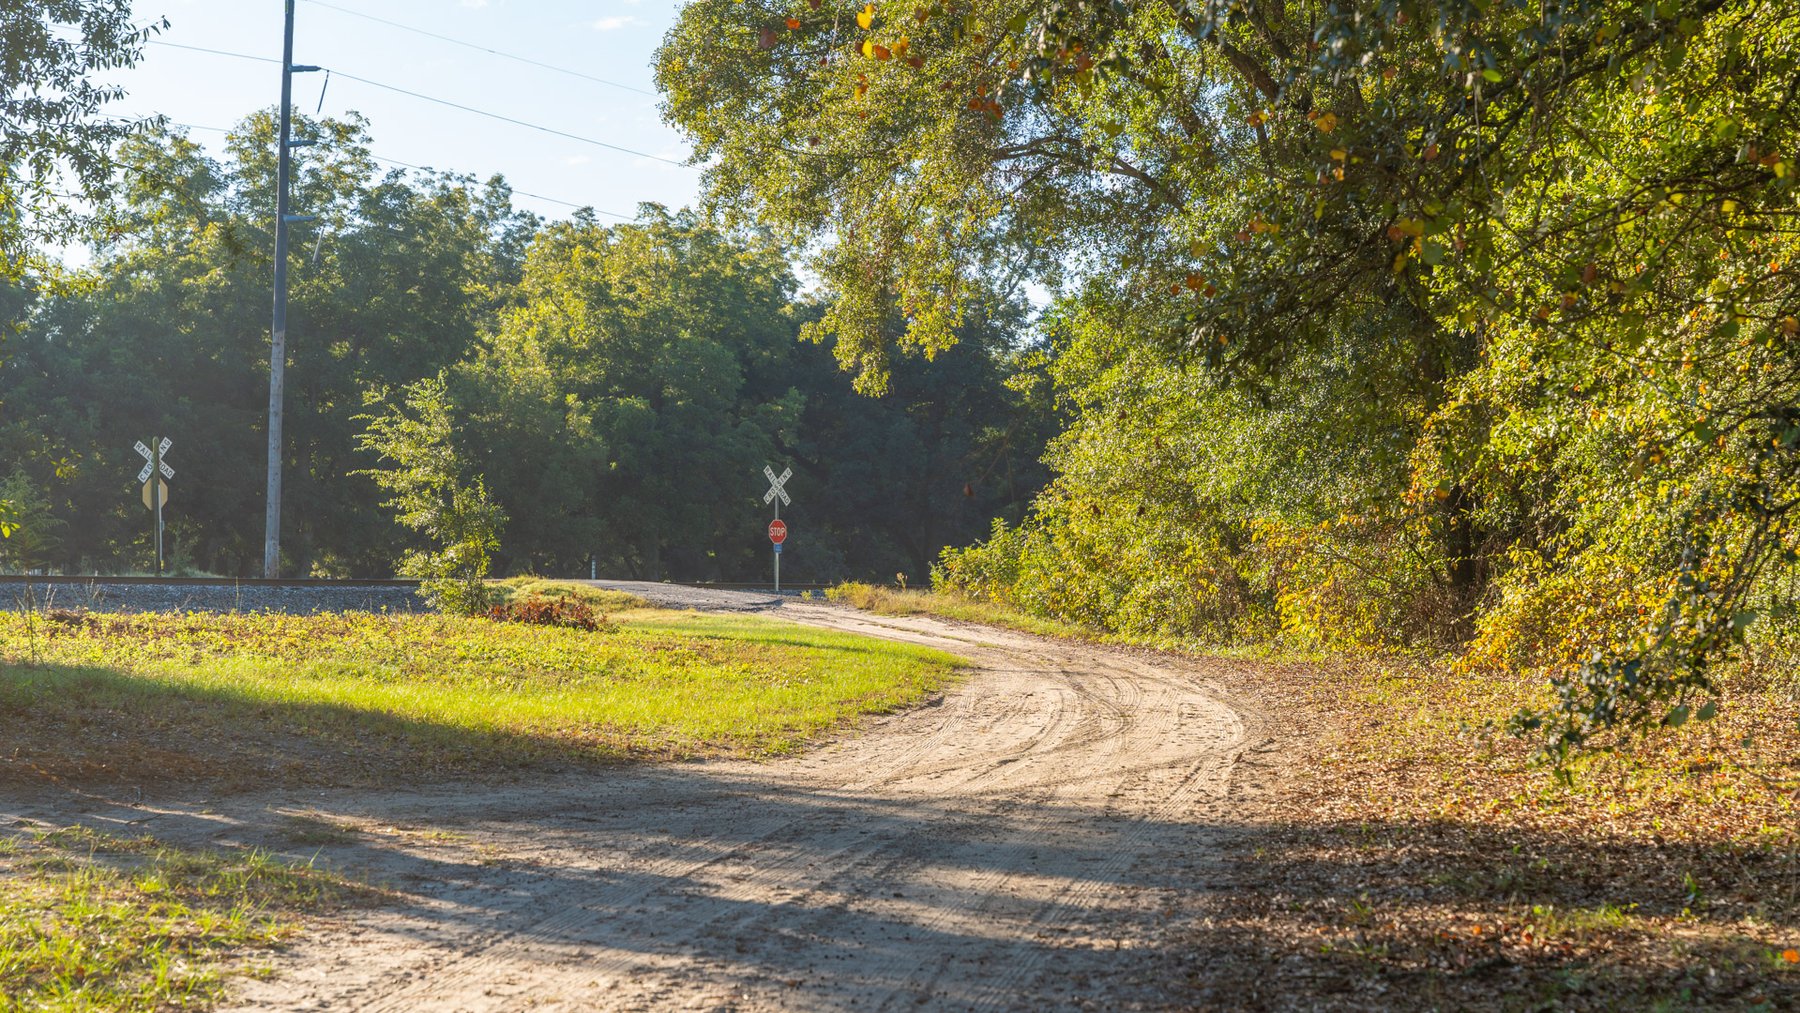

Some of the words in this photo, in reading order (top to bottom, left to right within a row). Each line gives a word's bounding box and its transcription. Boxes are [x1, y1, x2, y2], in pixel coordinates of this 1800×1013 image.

[159, 461, 173, 478] OAD
[764, 469, 791, 503] CROSSING
[770, 527, 785, 537] STOP
